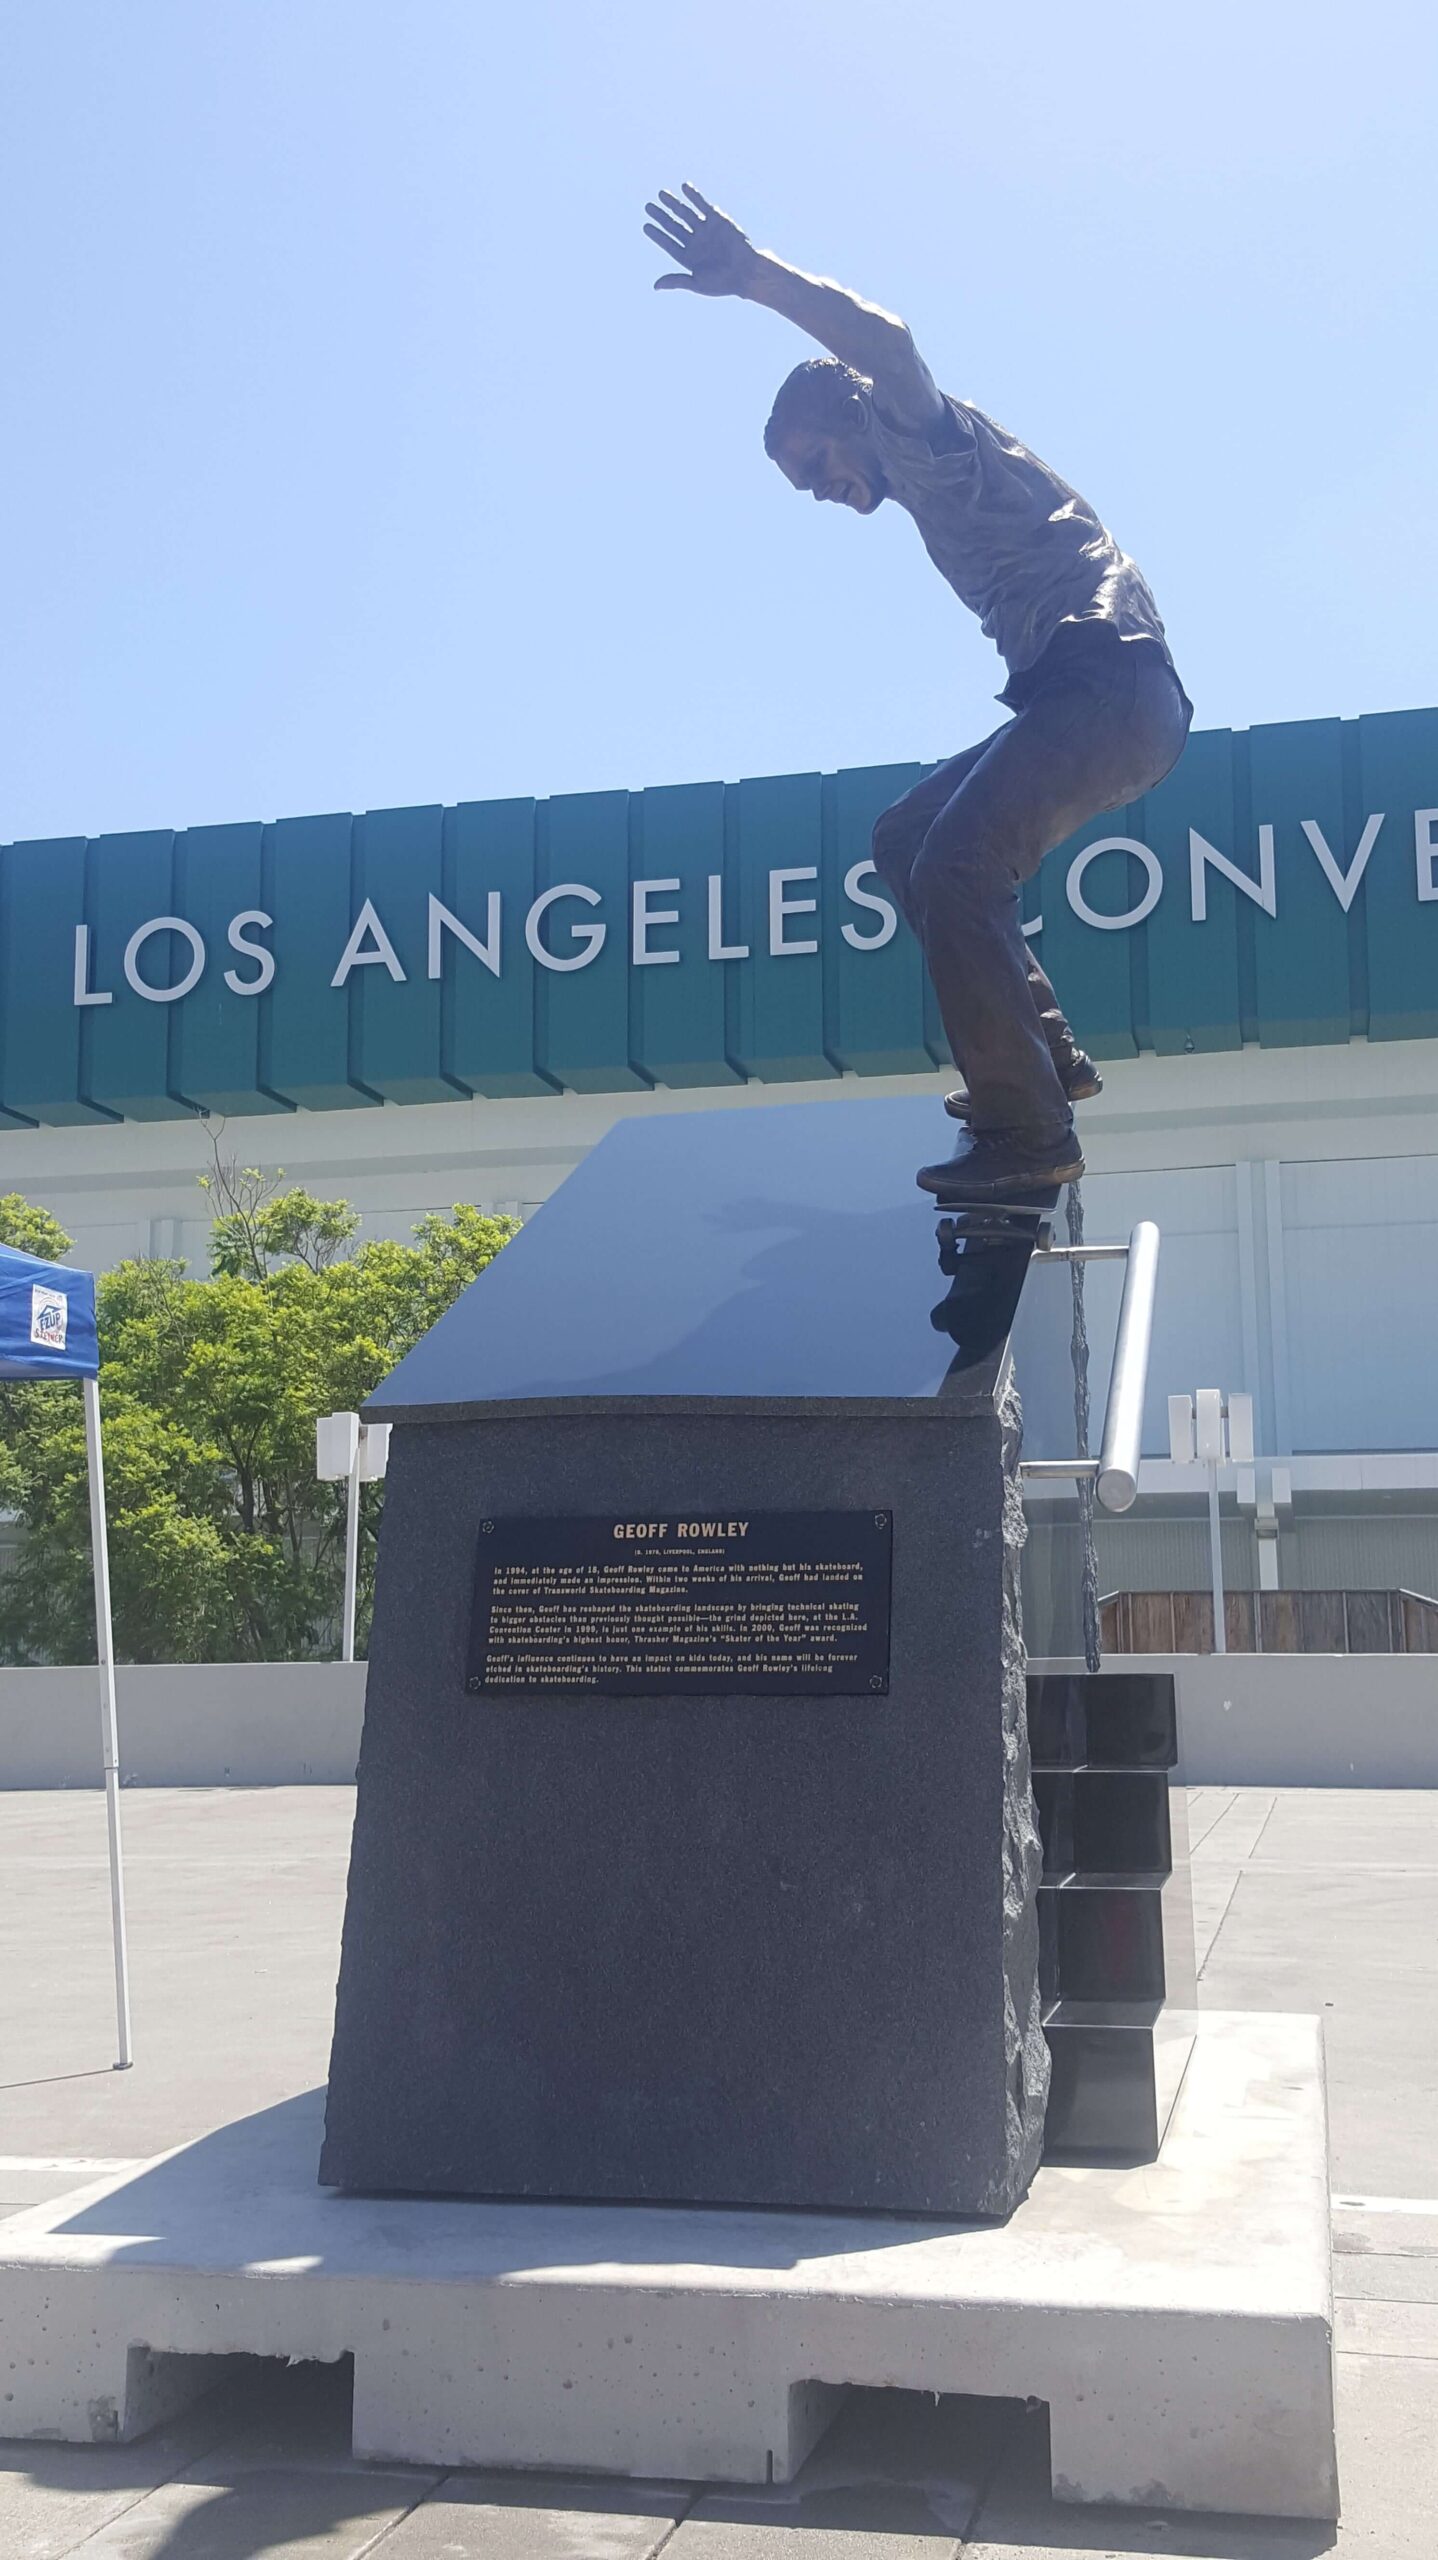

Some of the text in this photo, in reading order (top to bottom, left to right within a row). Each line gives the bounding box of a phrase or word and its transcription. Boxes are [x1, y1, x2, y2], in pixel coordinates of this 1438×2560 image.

[74, 808, 1438, 1006] LOS ANGELES ONVE
[613, 1522, 749, 1539] GEOFF ROWLEY
[494, 1567, 502, 1575] In
[506, 1567, 528, 1575] 1994,
[576, 1566, 584, 1574] of
[603, 1565, 625, 1573] Geoff
[628, 1565, 654, 1574] Rowley
[681, 1565, 690, 1573] to
[693, 1564, 725, 1572] America
[728, 1564, 745, 1572] with
[749, 1563, 779, 1572] nothing
[782, 1563, 796, 1571] but
[799, 1563, 811, 1571] his
[815, 1562, 863, 1571] skateboard,
[493, 1577, 508, 1585] and
[511, 1576, 557, 1585] immediately
[560, 1576, 581, 1584] made
[597, 1576, 642, 1584] impression.
[646, 1575, 671, 1583] Within
[674, 1575, 688, 1583] two
[719, 1574, 727, 1582] of
[730, 1574, 742, 1582] his
[746, 1574, 775, 1583] arrival,
[779, 1573, 801, 1581] Geoff
[804, 1573, 819, 1581] had
[822, 1573, 849, 1581] landed
[493, 1587, 505, 1595] the
[533, 1586, 541, 1595] of
[544, 1586, 586, 1594] Transworld
[589, 1586, 646, 1595] Skateboarding
[649, 1585, 688, 1594] Magazine.
[515, 1605, 535, 1614] then,
[539, 1605, 560, 1613] Geoff
[563, 1605, 577, 1613] has
[580, 1604, 615, 1613] reshaped
[635, 1604, 691, 1613] skateboarding
[694, 1604, 734, 1612] landscape
[738, 1603, 747, 1612] by
[750, 1603, 784, 1612] bringing
[787, 1603, 825, 1611] technical
[829, 1602, 859, 1611] skating
[490, 1616, 498, 1624] to
[502, 1616, 526, 1624] bigger
[529, 1615, 566, 1623] obstacles
[570, 1615, 587, 1623] than
[590, 1615, 631, 1624] previously
[634, 1615, 664, 1623] thought
[725, 1614, 746, 1623] grind
[750, 1613, 784, 1622] depicted
[788, 1613, 809, 1622] here,
[813, 1613, 821, 1621] at
[842, 1613, 858, 1621] L.A.
[489, 1626, 531, 1634] Convention
[564, 1625, 572, 1633] in
[602, 1625, 609, 1633] is
[612, 1625, 628, 1634] just
[649, 1625, 681, 1633] example
[696, 1624, 708, 1632] his
[712, 1624, 736, 1632] skills.
[740, 1624, 748, 1632] In
[751, 1624, 775, 1633] 2000,
[779, 1624, 801, 1632] Geoff
[823, 1623, 867, 1632] recognized
[488, 1636, 504, 1644] with
[573, 1635, 602, 1644] highest
[606, 1635, 630, 1644] honor,
[634, 1635, 669, 1643] Thrasher
[755, 1634, 763, 1642] of
[767, 1634, 780, 1642] the
[810, 1634, 837, 1642] award.
[517, 1654, 553, 1662] influence
[557, 1654, 595, 1662] continues
[610, 1654, 628, 1662] have
[645, 1654, 672, 1663] impact
[689, 1654, 705, 1662] kids
[709, 1654, 733, 1663] today,
[796, 1653, 811, 1661] will
[814, 1653, 824, 1661] be
[828, 1653, 858, 1661] forever
[486, 1665, 512, 1673] etched
[515, 1665, 522, 1673] in
[592, 1665, 622, 1674] history.
[737, 1664, 759, 1672] Geoff
[801, 1664, 833, 1673] lifelong
[485, 1675, 599, 1684] dedication to skateboarding.
